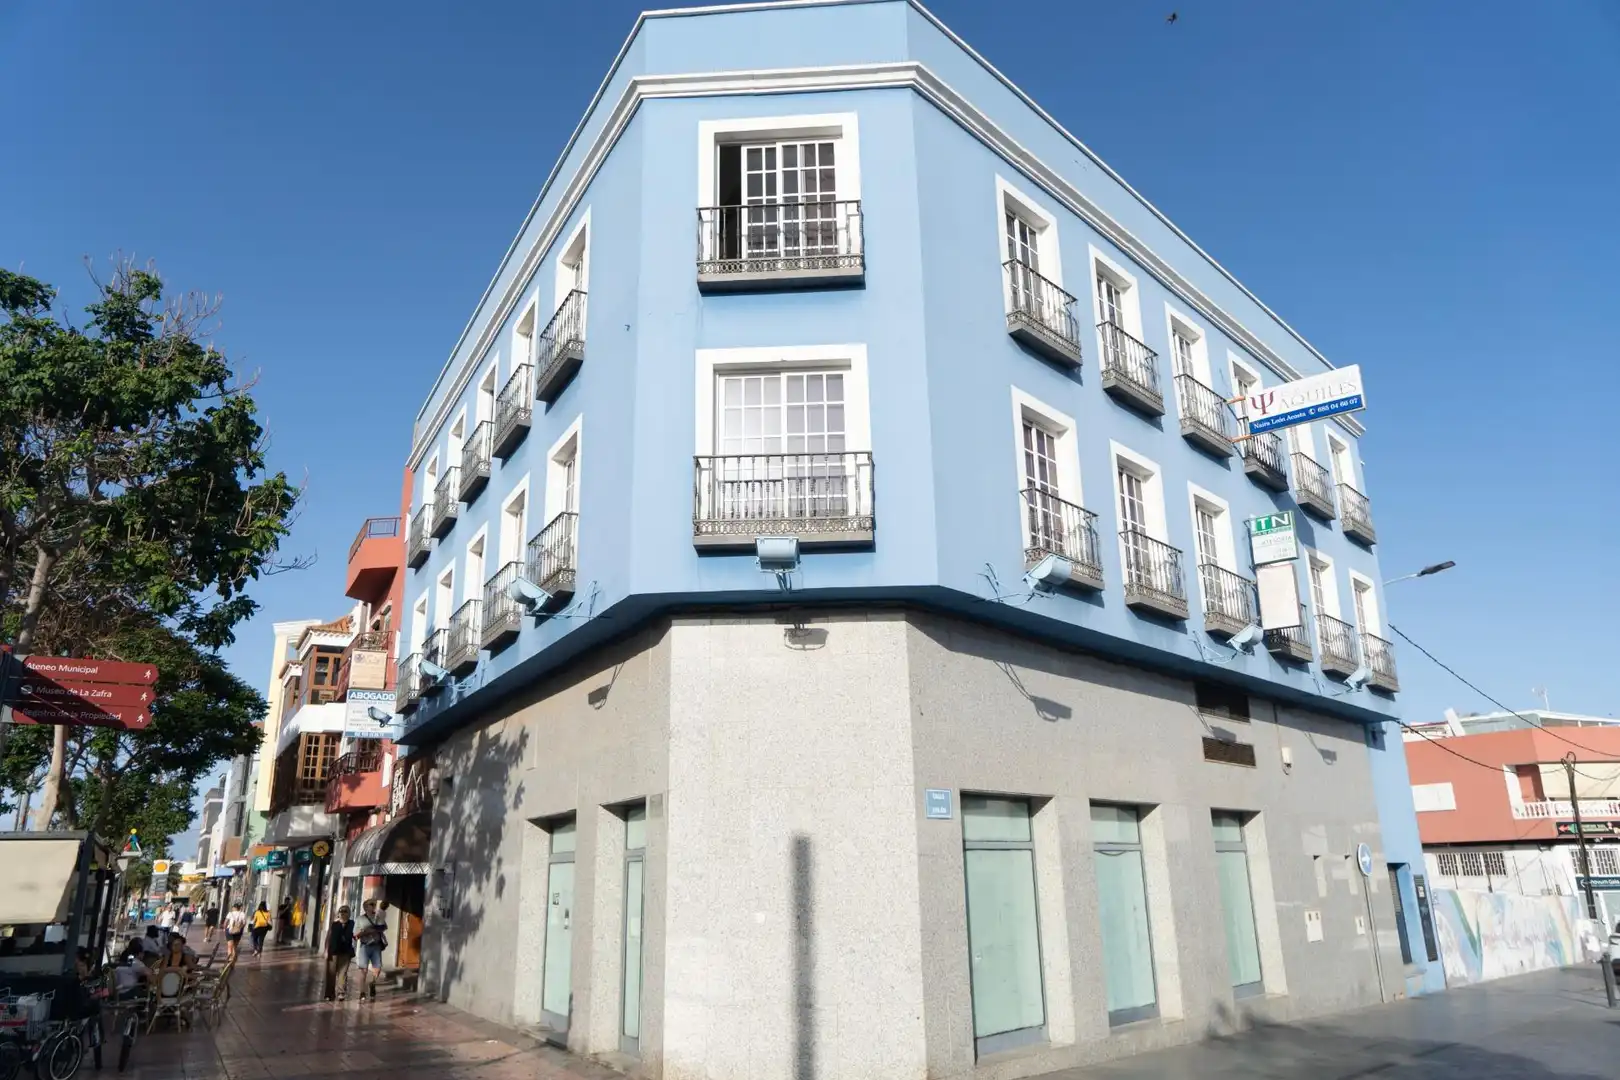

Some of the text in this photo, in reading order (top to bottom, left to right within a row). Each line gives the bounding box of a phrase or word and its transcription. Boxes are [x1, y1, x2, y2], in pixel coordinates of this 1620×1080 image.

[1279, 381, 1357, 409] AQUILES
[26, 662, 99, 674] Ateneo Municipal
[36, 687, 66, 696] Museo
[66, 687, 78, 696] de
[90, 689, 113, 698] Zafra
[349, 691, 396, 700] ABOGADO
[79, 711, 122, 721] Propiedad
